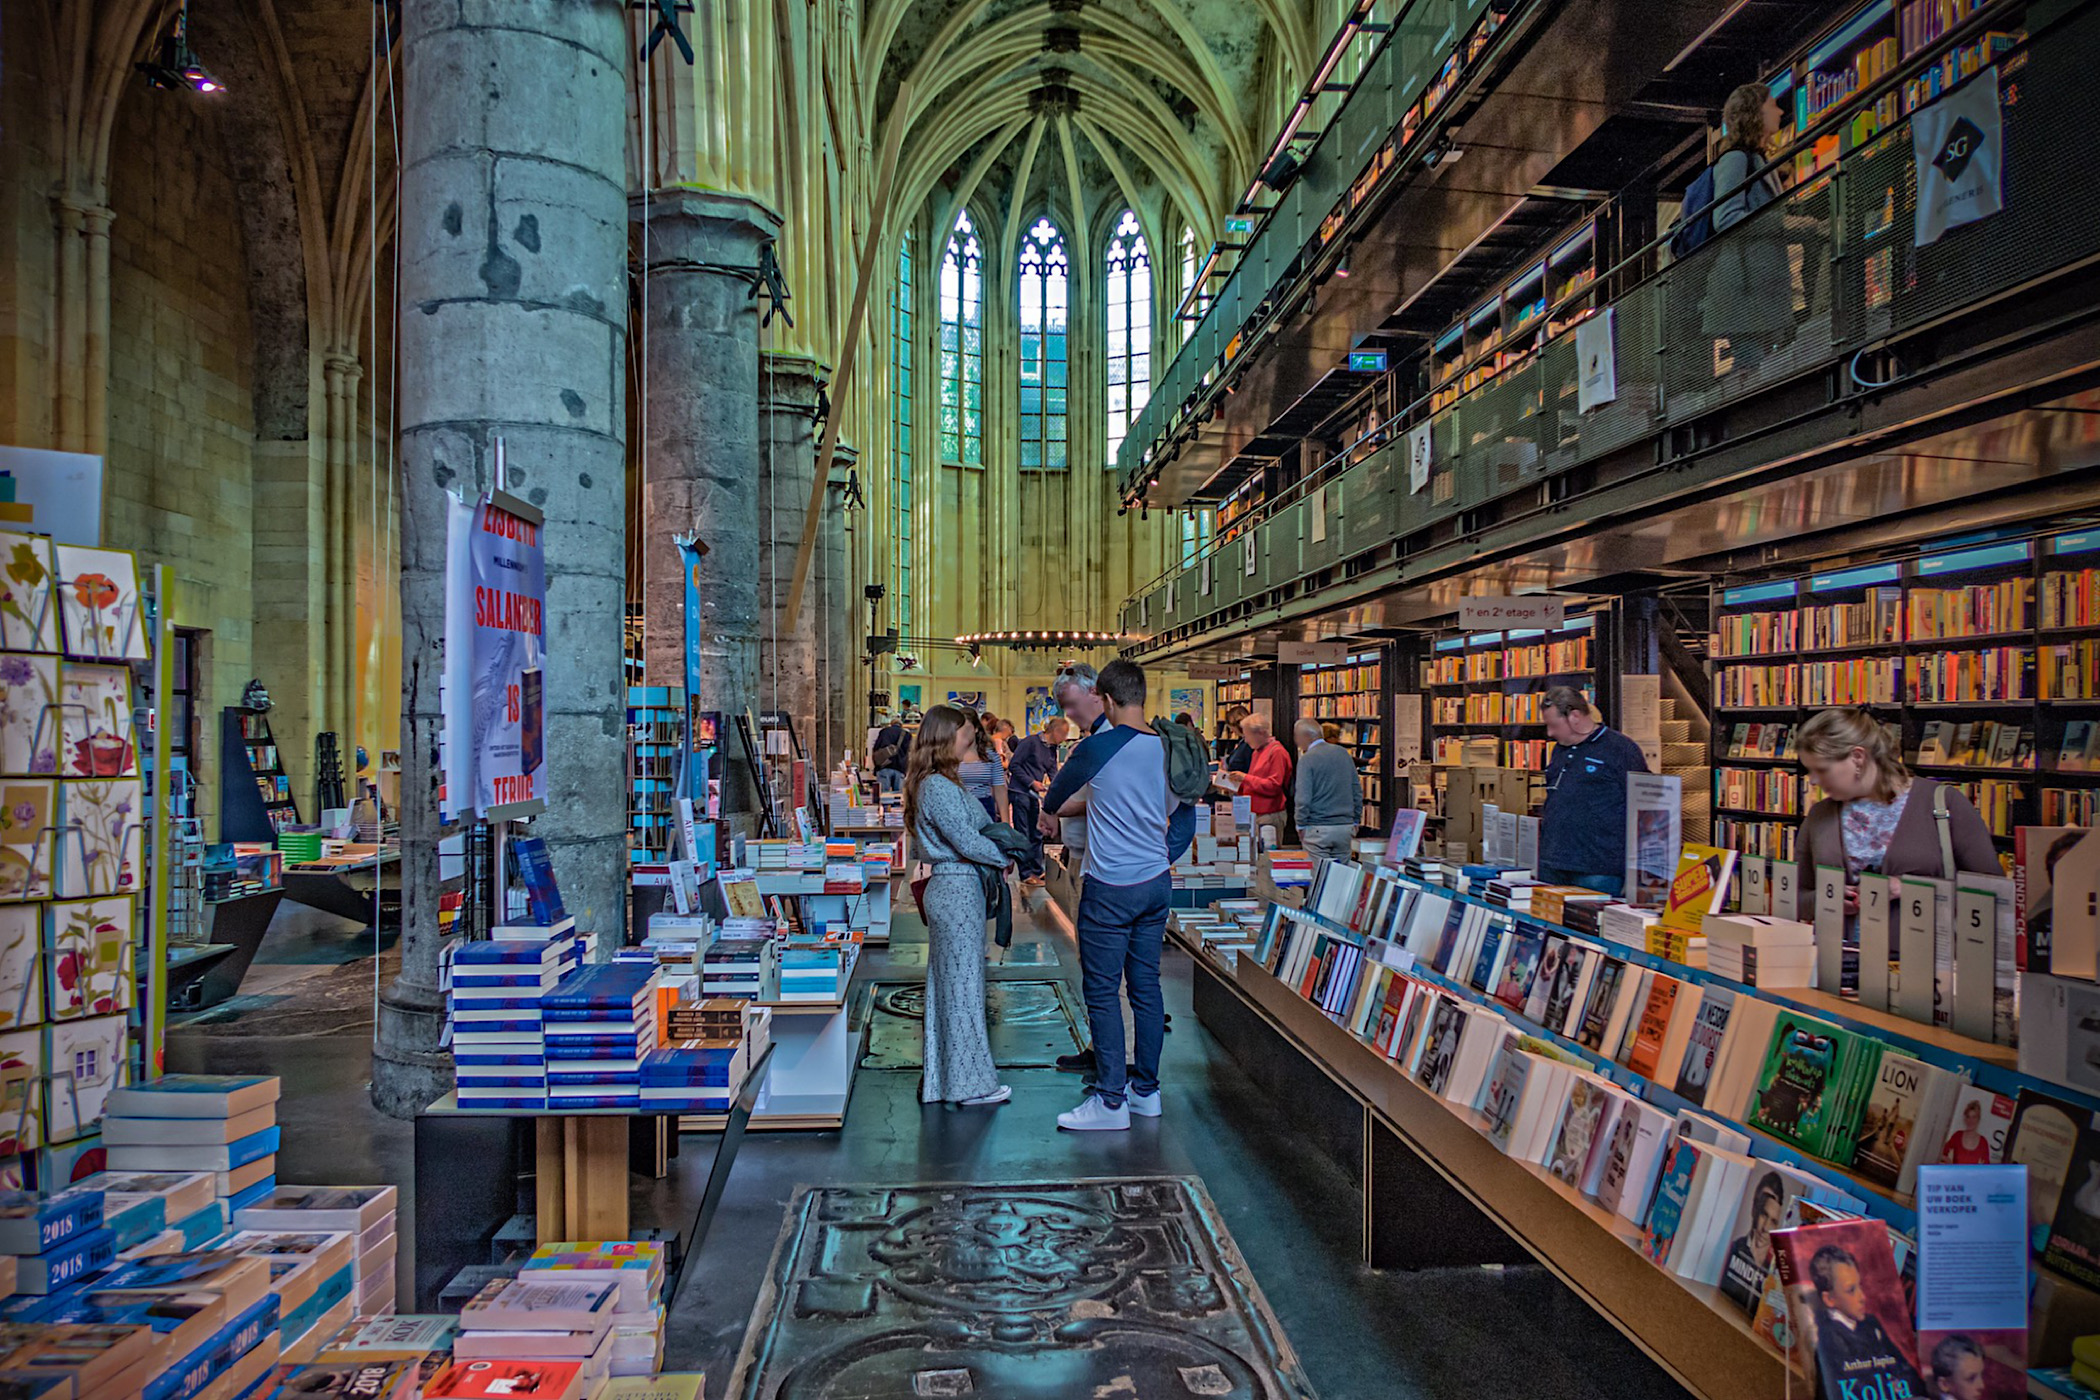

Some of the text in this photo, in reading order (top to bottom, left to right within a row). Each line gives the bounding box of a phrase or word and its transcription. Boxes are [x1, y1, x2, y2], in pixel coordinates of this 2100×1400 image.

[1946, 135, 1968, 163] SG
[476, 585, 541, 636] SALANDER
[1477, 609, 1490, 617] en
[1506, 608, 1536, 619] etage
[1711, 640, 1718, 650] e
[2067, 676, 2076, 687] n
[508, 684, 520, 723] IS
[1731, 792, 1739, 806] g
[1748, 869, 1759, 884] 10
[1781, 876, 1789, 891] 9
[1826, 883, 1834, 899] 8
[1870, 891, 1878, 907] 7
[1912, 900, 1922, 917] 6
[1971, 909, 1981, 928] 5
[1629, 1082, 1640, 1094] 44
[1882, 1065, 1919, 1093] LION
[1926, 1195, 1972, 1203] UW BOEK
[1926, 1206, 1978, 1214] VERKOPER
[43, 1214, 73, 1245] 2018
[52, 1253, 83, 1284] 2018
[1777, 1249, 1789, 1280] Kolja
[235, 1322, 259, 1353] 2018
[384, 1320, 422, 1343] KOK
[1843, 1357, 1872, 1371] Arthur
[184, 1360, 209, 1396] 2018
[350, 1367, 386, 1394] 2018
[1837, 1372, 1914, 1400] Kolja
